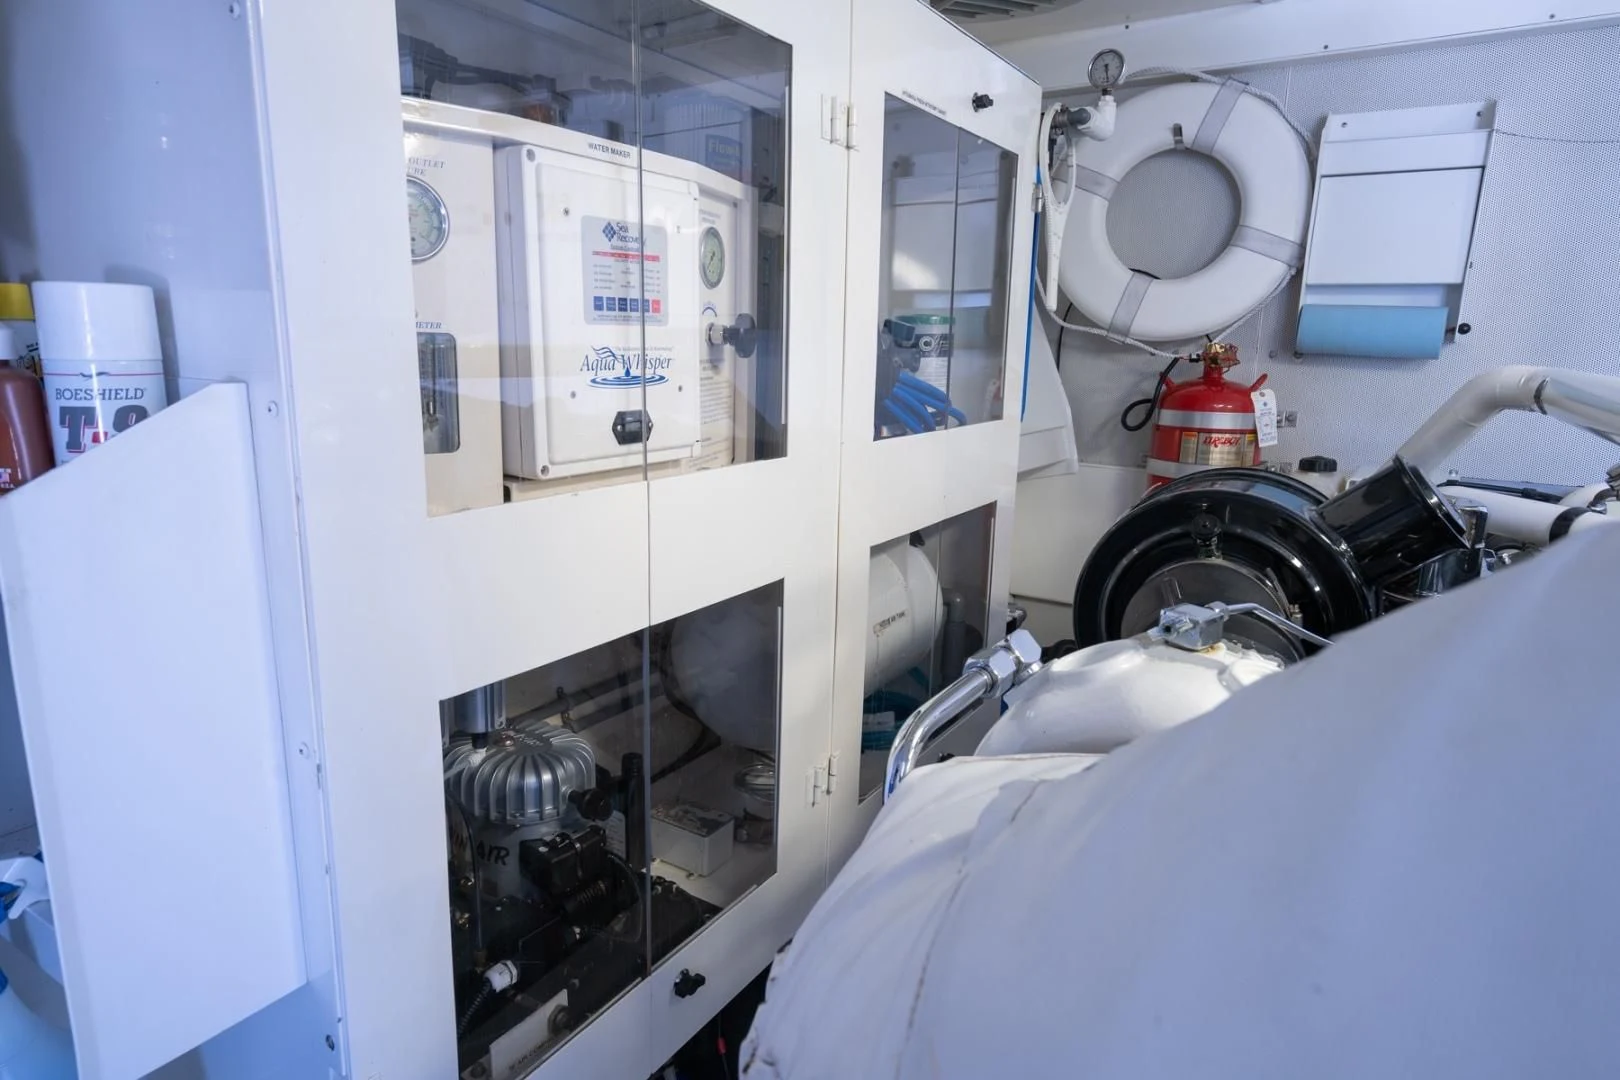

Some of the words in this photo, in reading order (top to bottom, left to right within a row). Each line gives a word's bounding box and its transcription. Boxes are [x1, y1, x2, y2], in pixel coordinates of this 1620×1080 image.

[587, 142, 610, 153] WATER
[610, 147, 631, 159] MAKER
[616, 222, 630, 234] Sea
[616, 232, 647, 247] Recovey
[580, 354, 616, 376] Aqua
[55, 387, 145, 401] BOESHIELD
[476, 839, 510, 866] AIR
